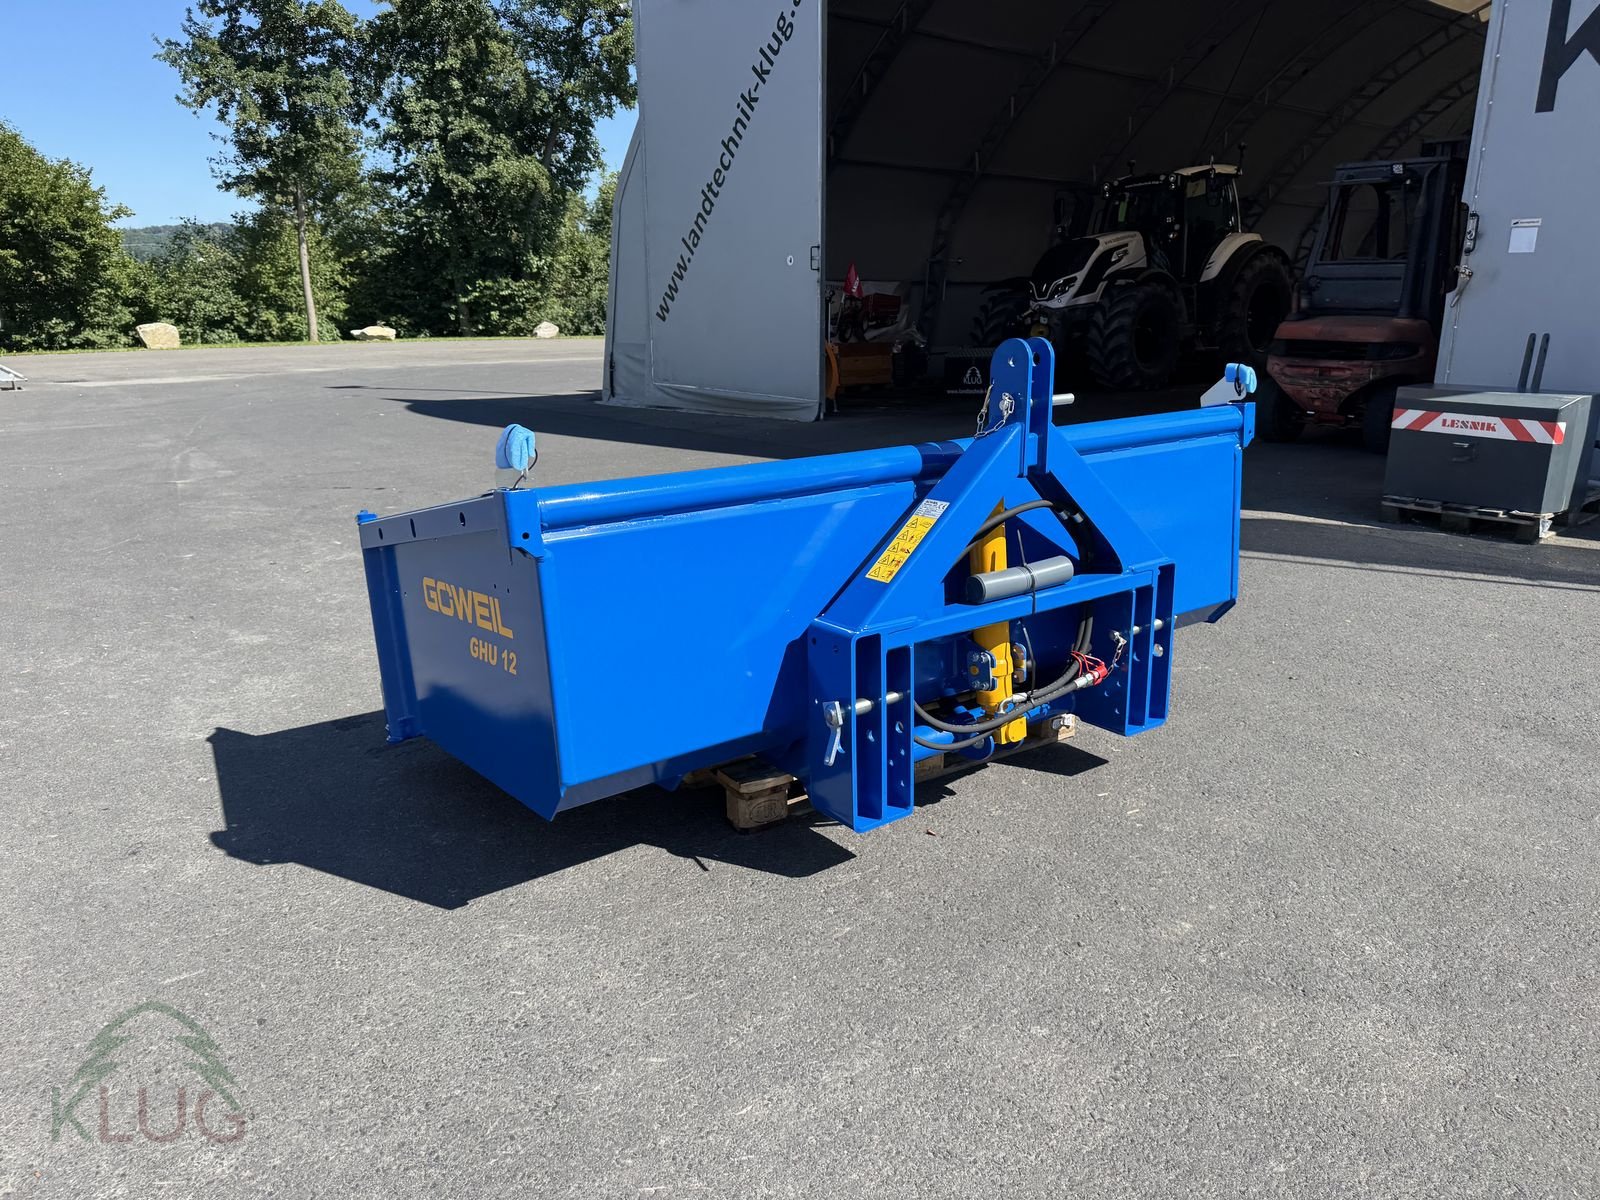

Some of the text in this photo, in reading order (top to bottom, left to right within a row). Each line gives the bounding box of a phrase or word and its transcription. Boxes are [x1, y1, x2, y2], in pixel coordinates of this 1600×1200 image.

[1441, 418, 1497, 432] LESNIK
[470, 637, 517, 675] GHU 12
